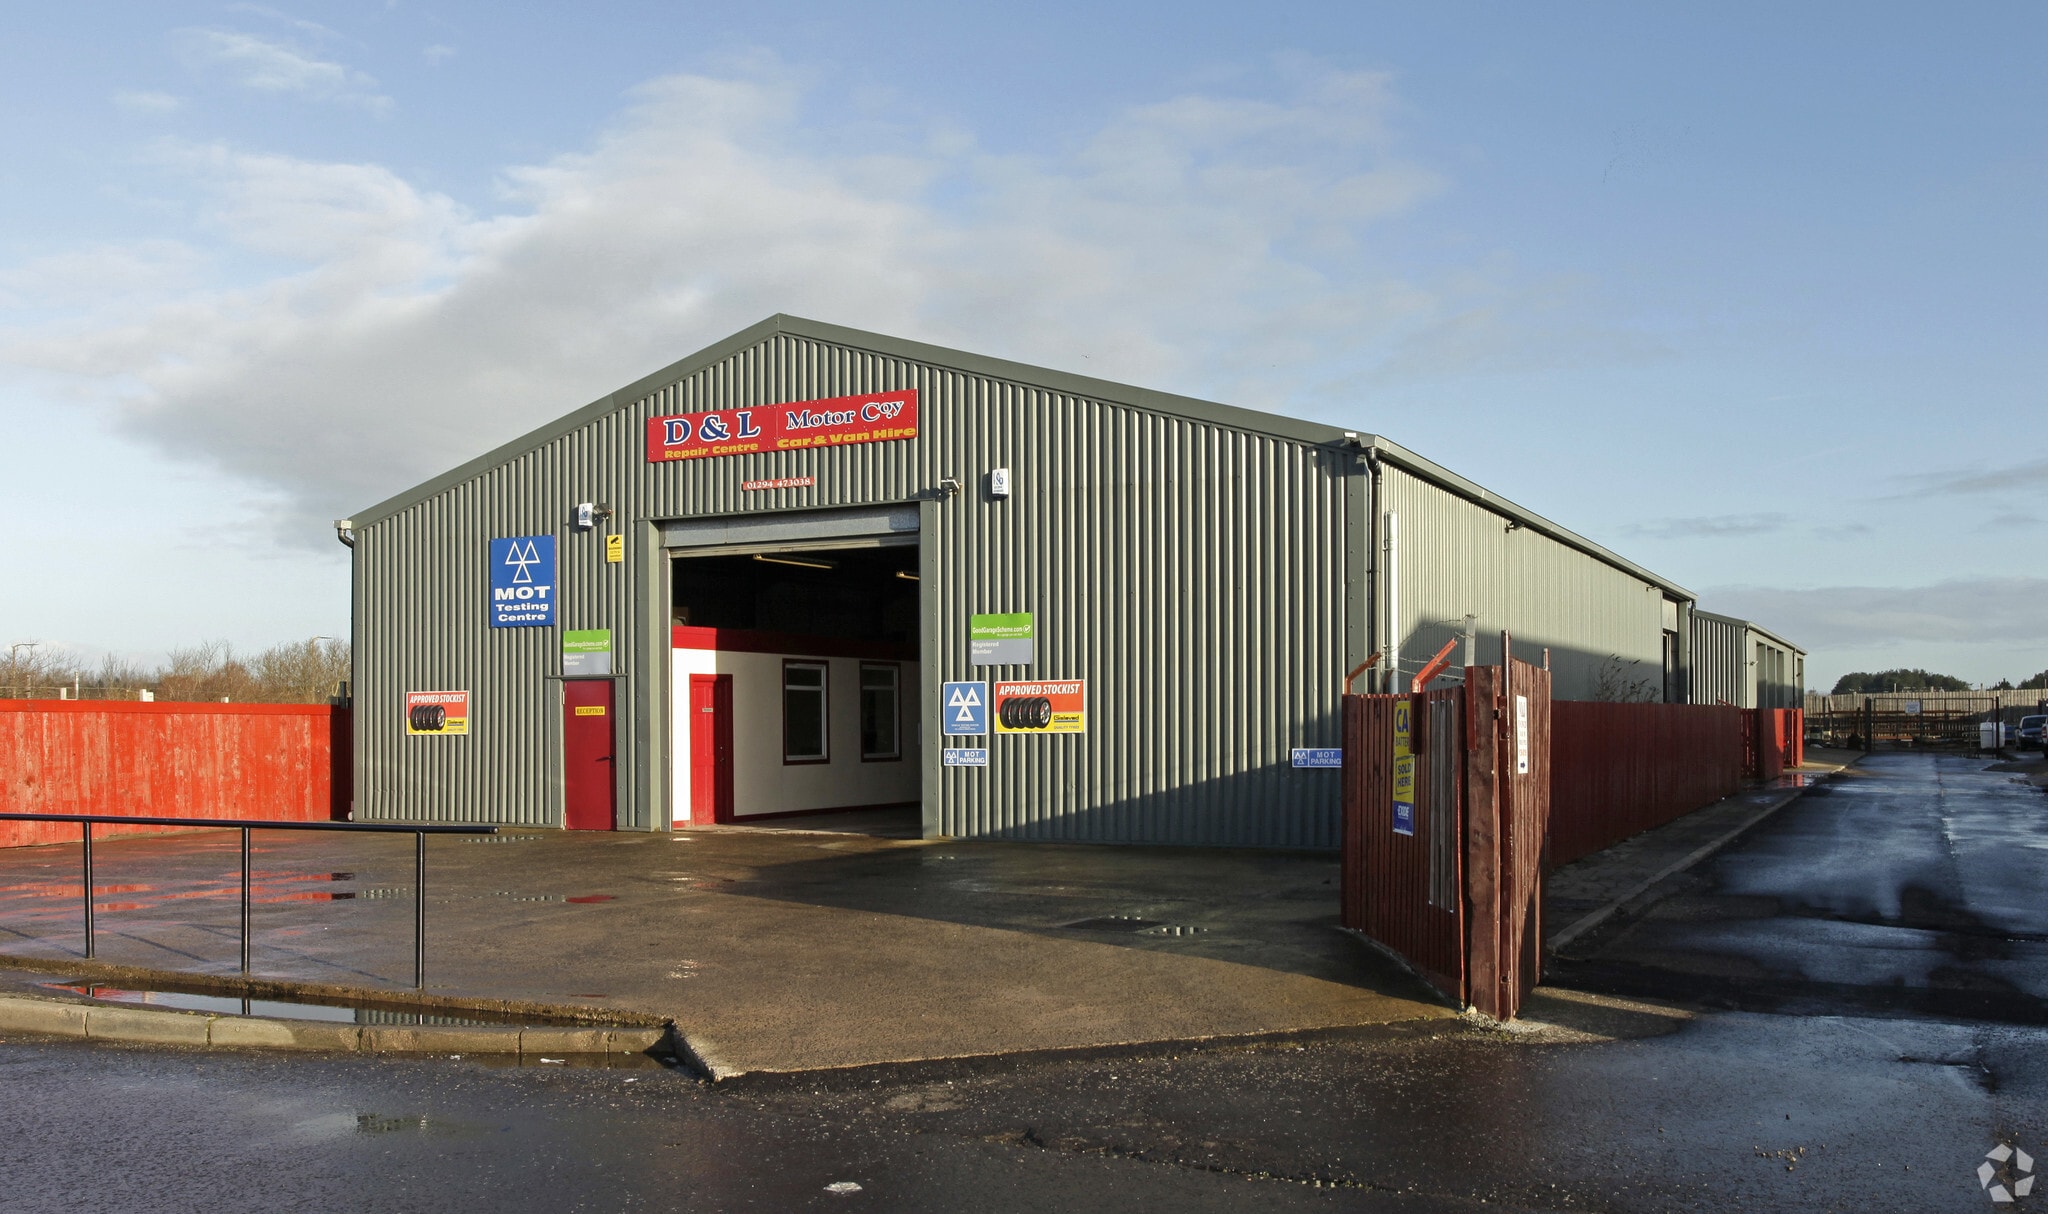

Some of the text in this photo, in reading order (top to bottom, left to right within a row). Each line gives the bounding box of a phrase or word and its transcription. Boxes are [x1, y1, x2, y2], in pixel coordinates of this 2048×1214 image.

[663, 401, 904, 446] D & L Motor Coy
[829, 432, 870, 444] Van
[873, 427, 916, 439] Hire
[664, 443, 759, 459] Repair Centre
[746, 478, 811, 489] 01294 473038
[494, 585, 551, 601] MOT
[495, 602, 549, 612] Testing
[498, 613, 546, 622] Centre
[998, 683, 1080, 696] APPROVED STOCKIST
[409, 694, 466, 704] APPROVED STOCKIST
[1396, 708, 1409, 733] CA
[1310, 757, 1342, 765] PARKING
[1397, 762, 1411, 775] SOLD
[1397, 775, 1411, 788] HERE
